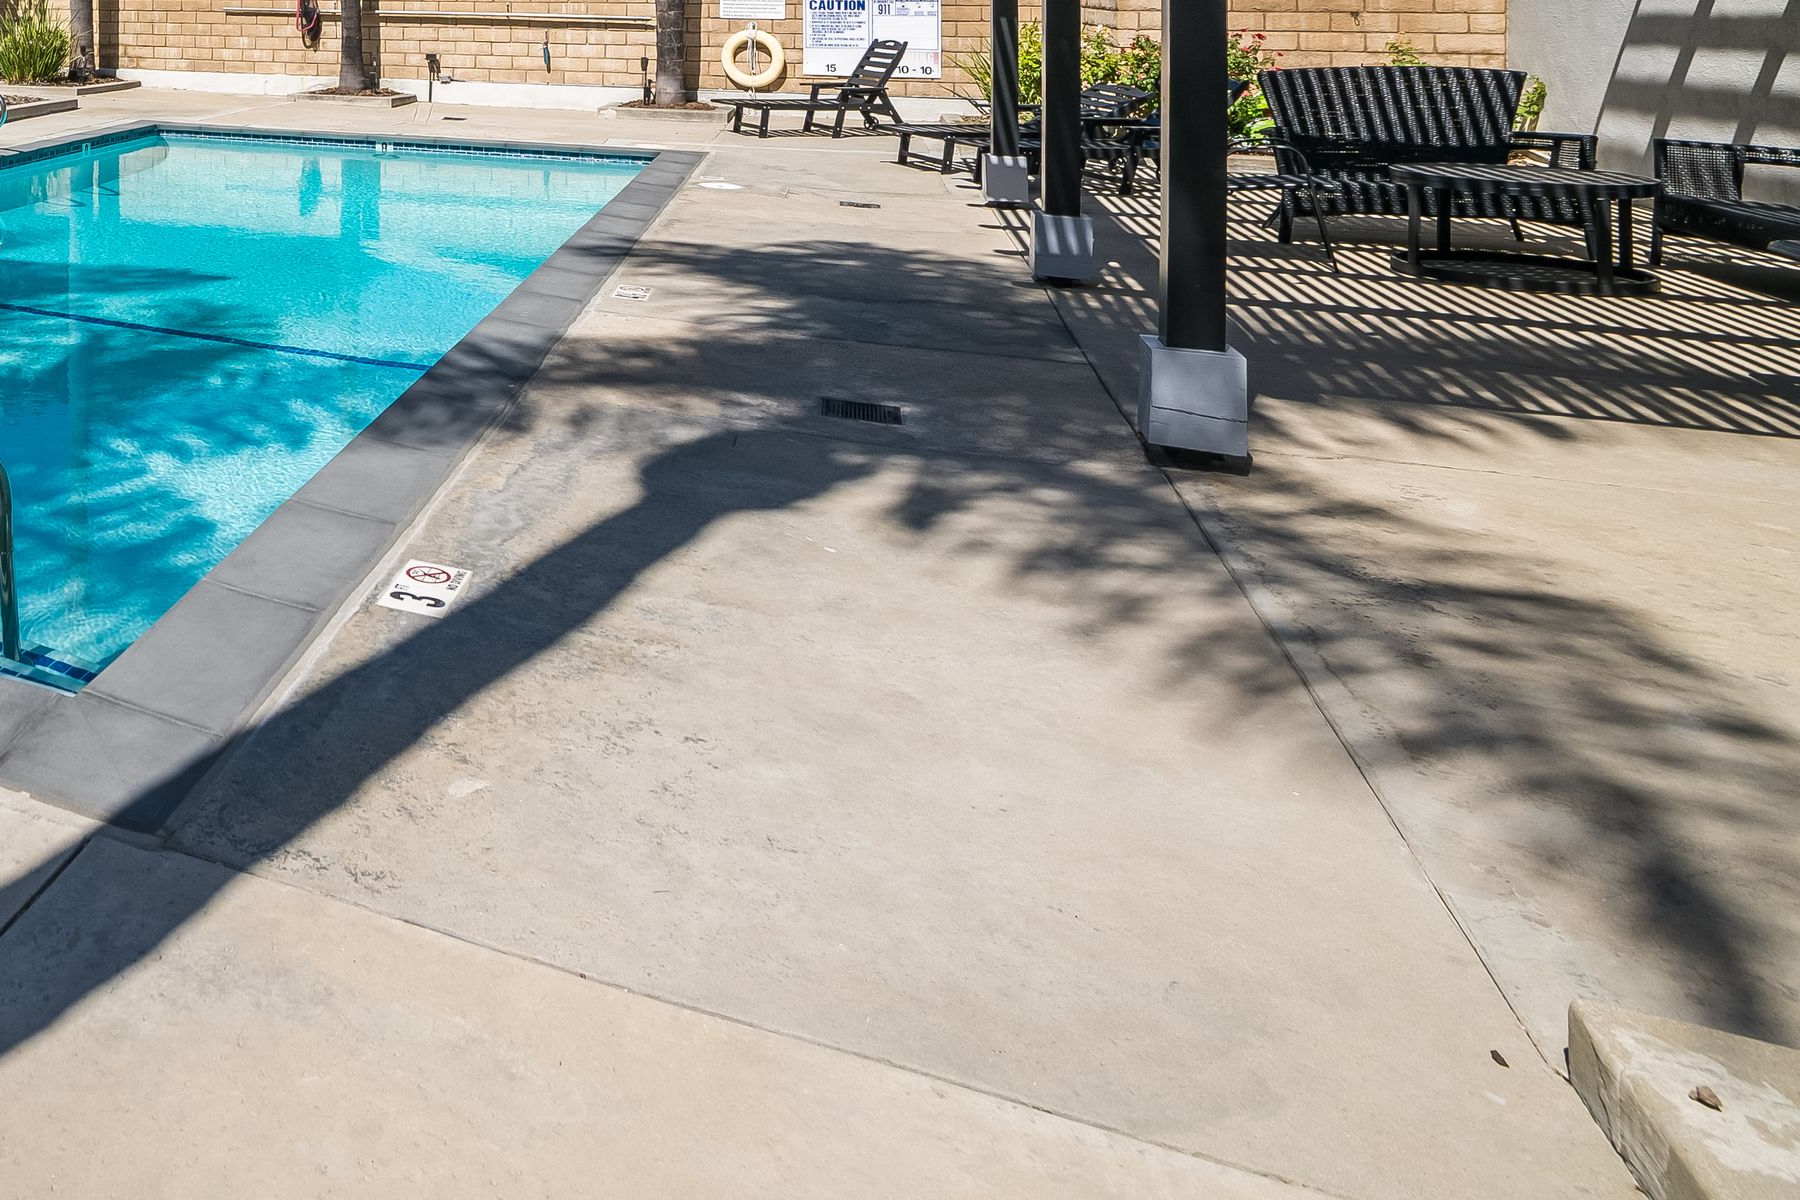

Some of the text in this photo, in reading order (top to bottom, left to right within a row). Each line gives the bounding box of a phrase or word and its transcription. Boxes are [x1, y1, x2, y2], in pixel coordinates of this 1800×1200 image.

[809, 0, 866, 11] CAUTION
[878, 4, 890, 15] 911
[826, 64, 837, 72] 15
[897, 65, 909, 74] 10
[920, 66, 932, 75] 10
[389, 591, 446, 608] 3
